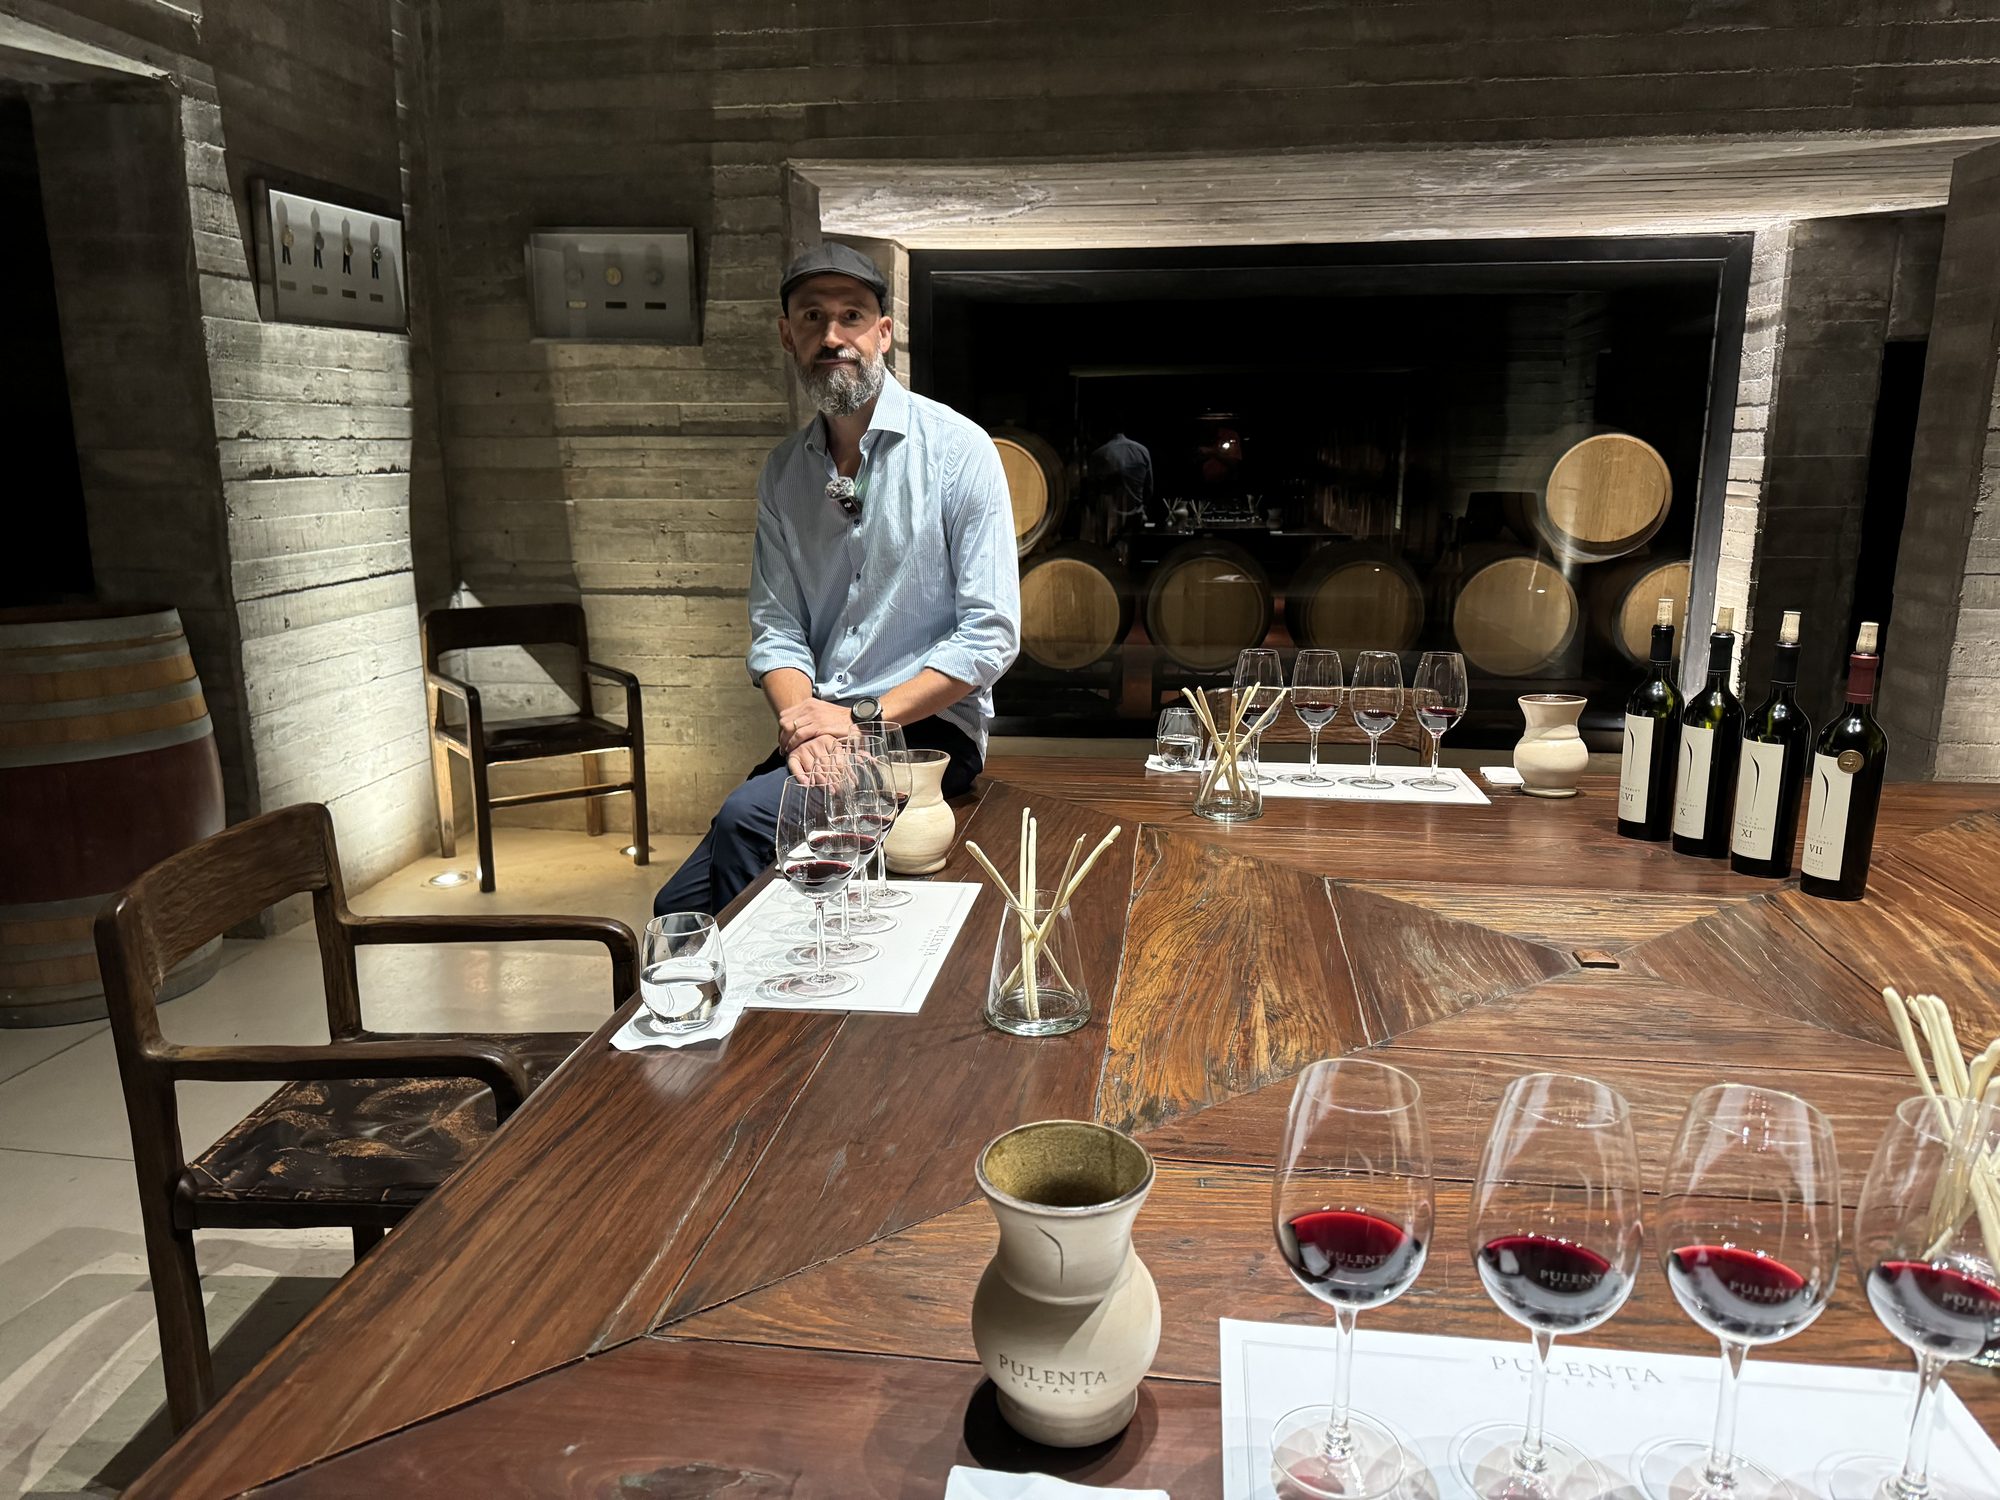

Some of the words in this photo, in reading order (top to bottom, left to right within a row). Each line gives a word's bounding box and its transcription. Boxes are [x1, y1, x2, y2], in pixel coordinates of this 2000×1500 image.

[1741, 828, 1752, 838] XI
[1809, 843, 1823, 855] VII
[1325, 1249, 1386, 1265] PULENT
[1540, 1269, 1602, 1284] PULENT
[1729, 1280, 1796, 1299] PULENT
[999, 1353, 1108, 1386] PULENTA
[1011, 1376, 1091, 1395] ESTATE
[1520, 1374, 1640, 1392] ETATE
